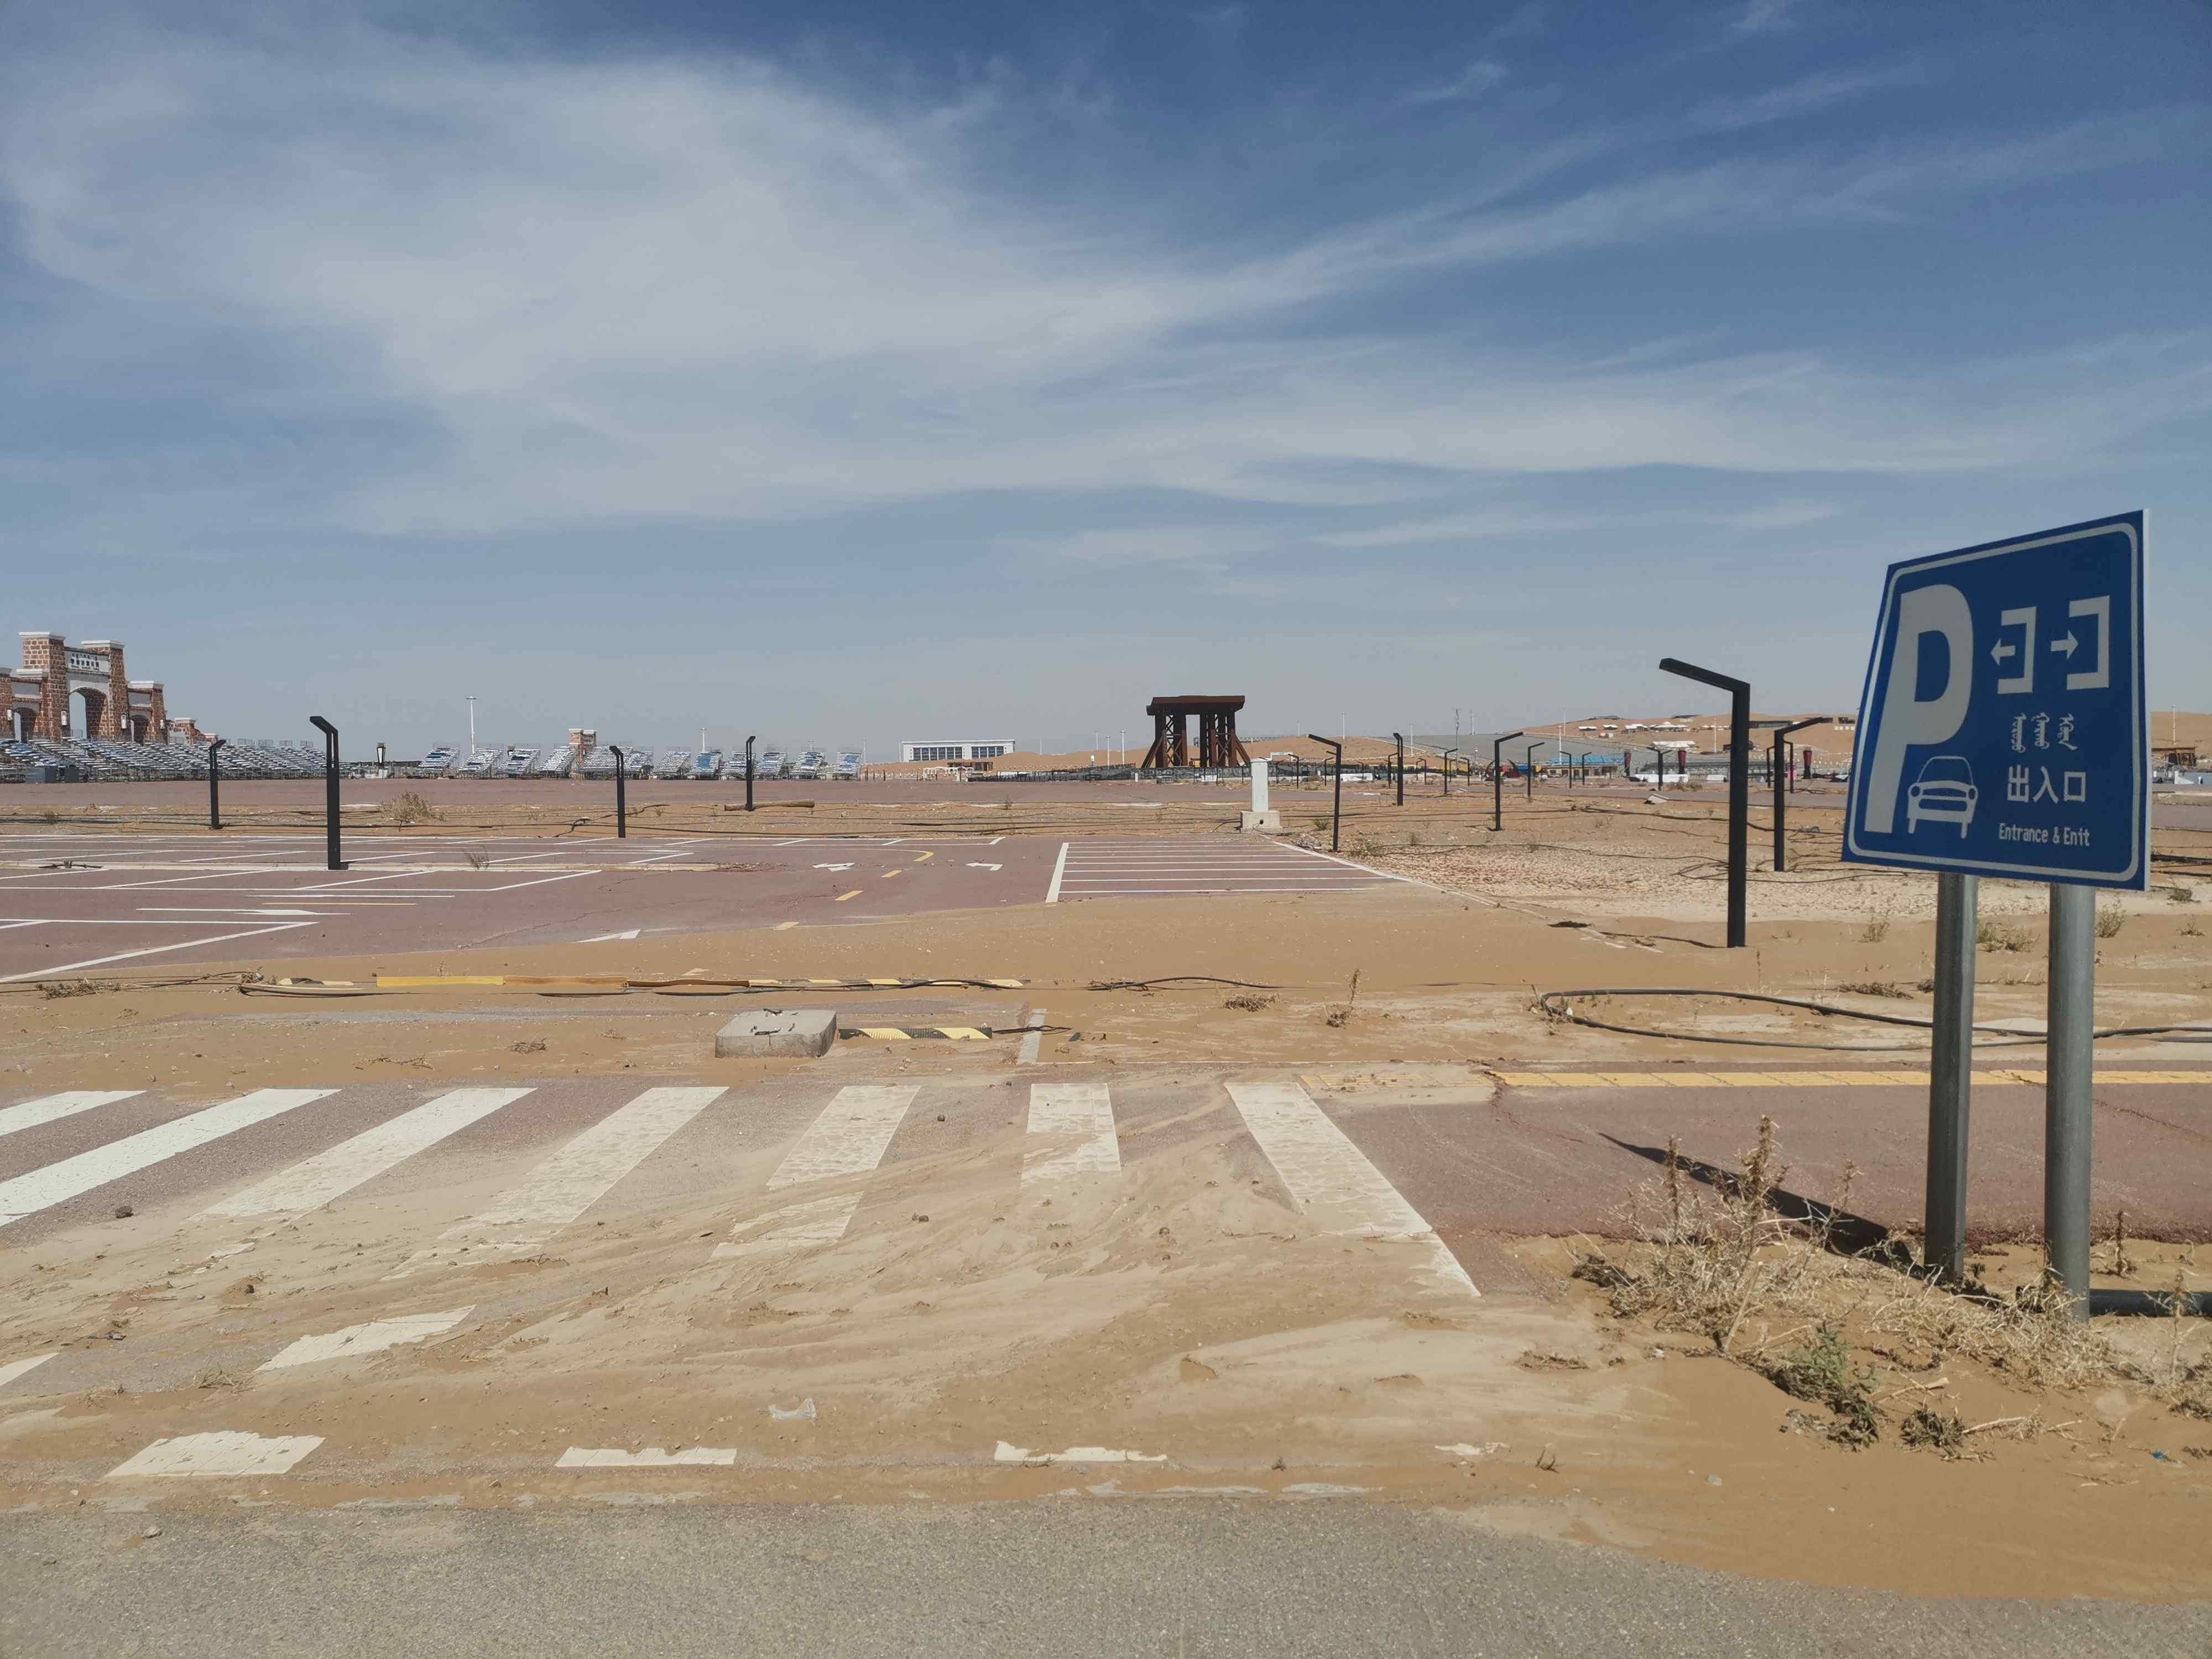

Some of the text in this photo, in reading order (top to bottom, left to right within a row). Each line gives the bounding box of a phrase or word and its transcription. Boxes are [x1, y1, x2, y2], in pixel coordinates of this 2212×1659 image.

[1864, 584, 1974, 833] P
[2007, 764, 2086, 804] 出入口
[1999, 822, 2048, 843] Entrance
[2053, 826, 2060, 843] &
